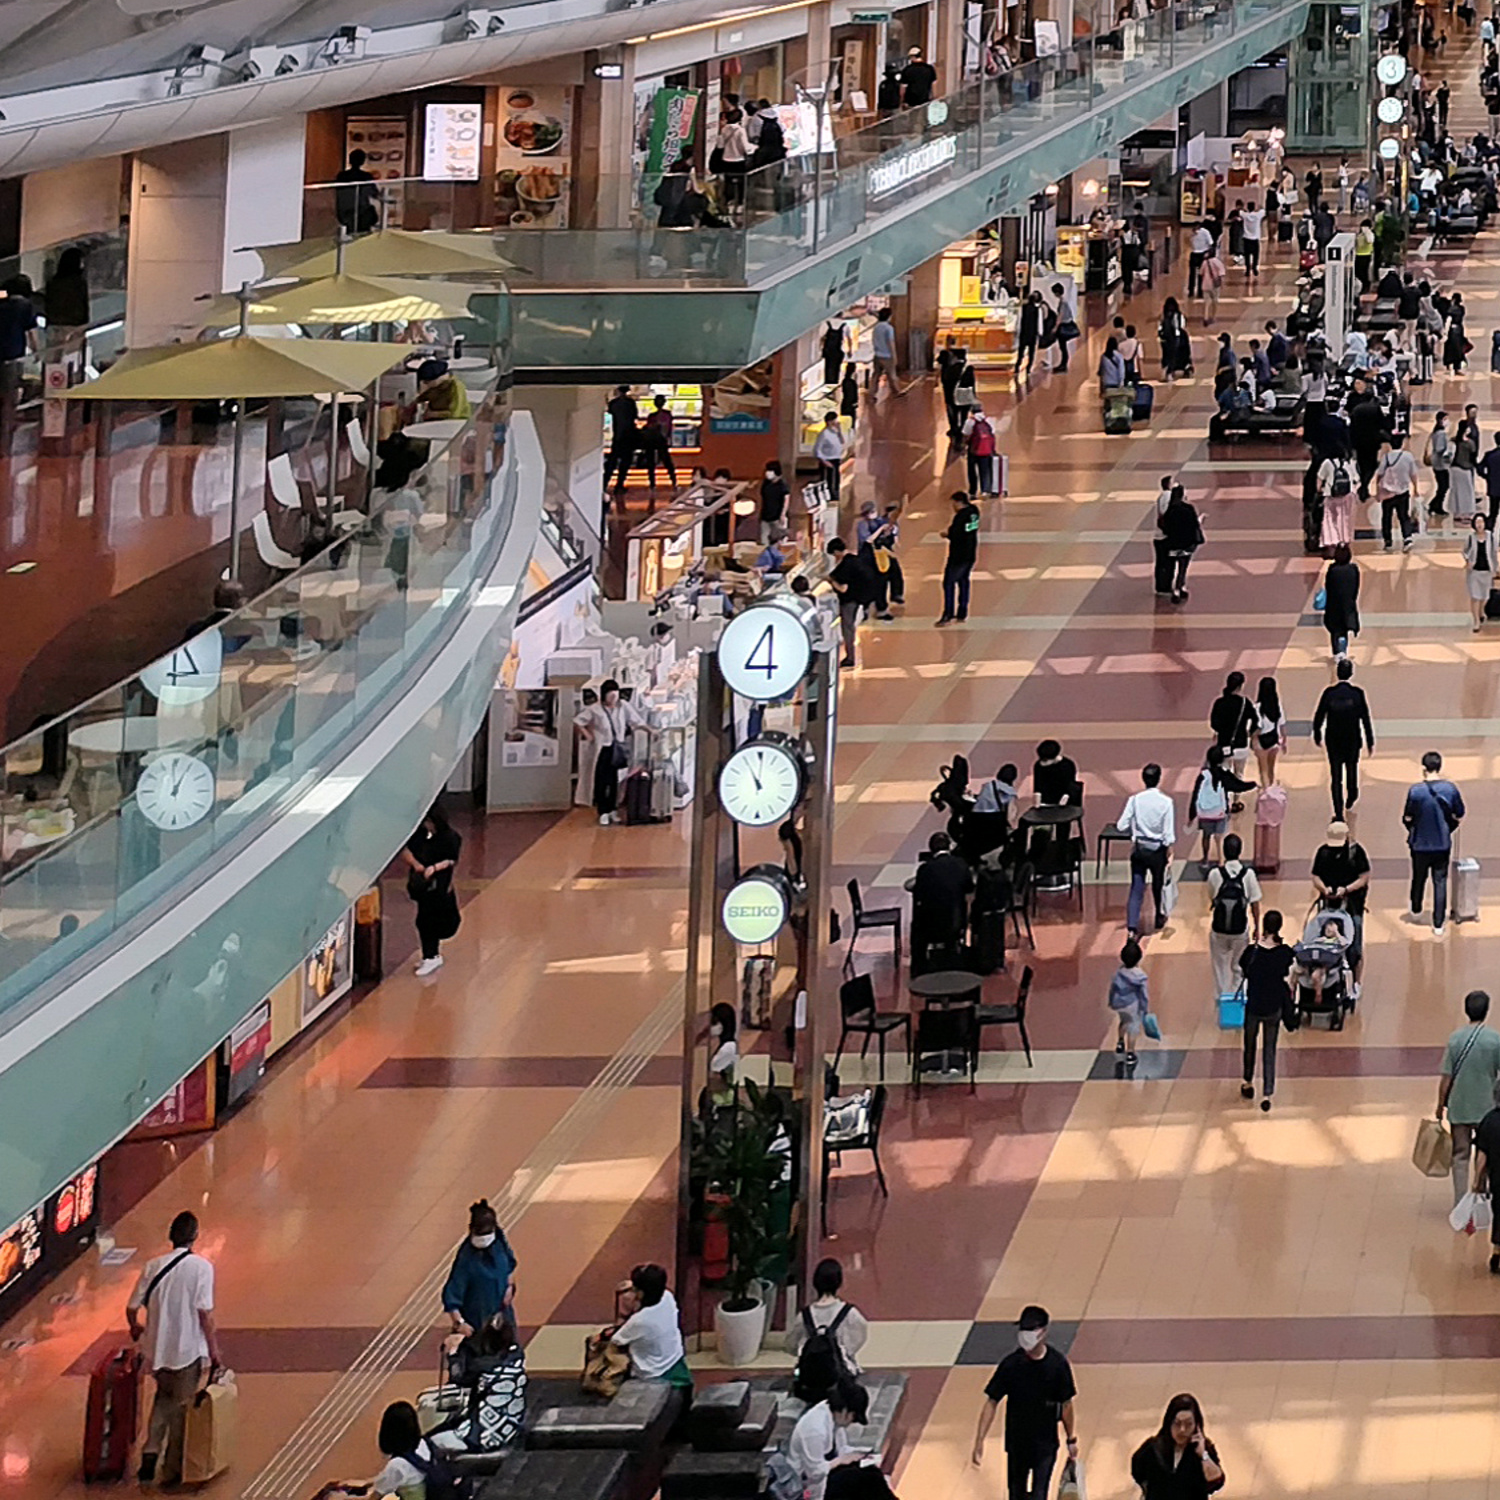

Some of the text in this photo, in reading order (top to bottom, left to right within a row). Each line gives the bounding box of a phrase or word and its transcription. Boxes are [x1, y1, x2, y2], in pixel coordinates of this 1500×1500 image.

[1385, 60, 1397, 79] 3
[743, 624, 779, 680] 4
[727, 906, 780, 918] SEIKO
